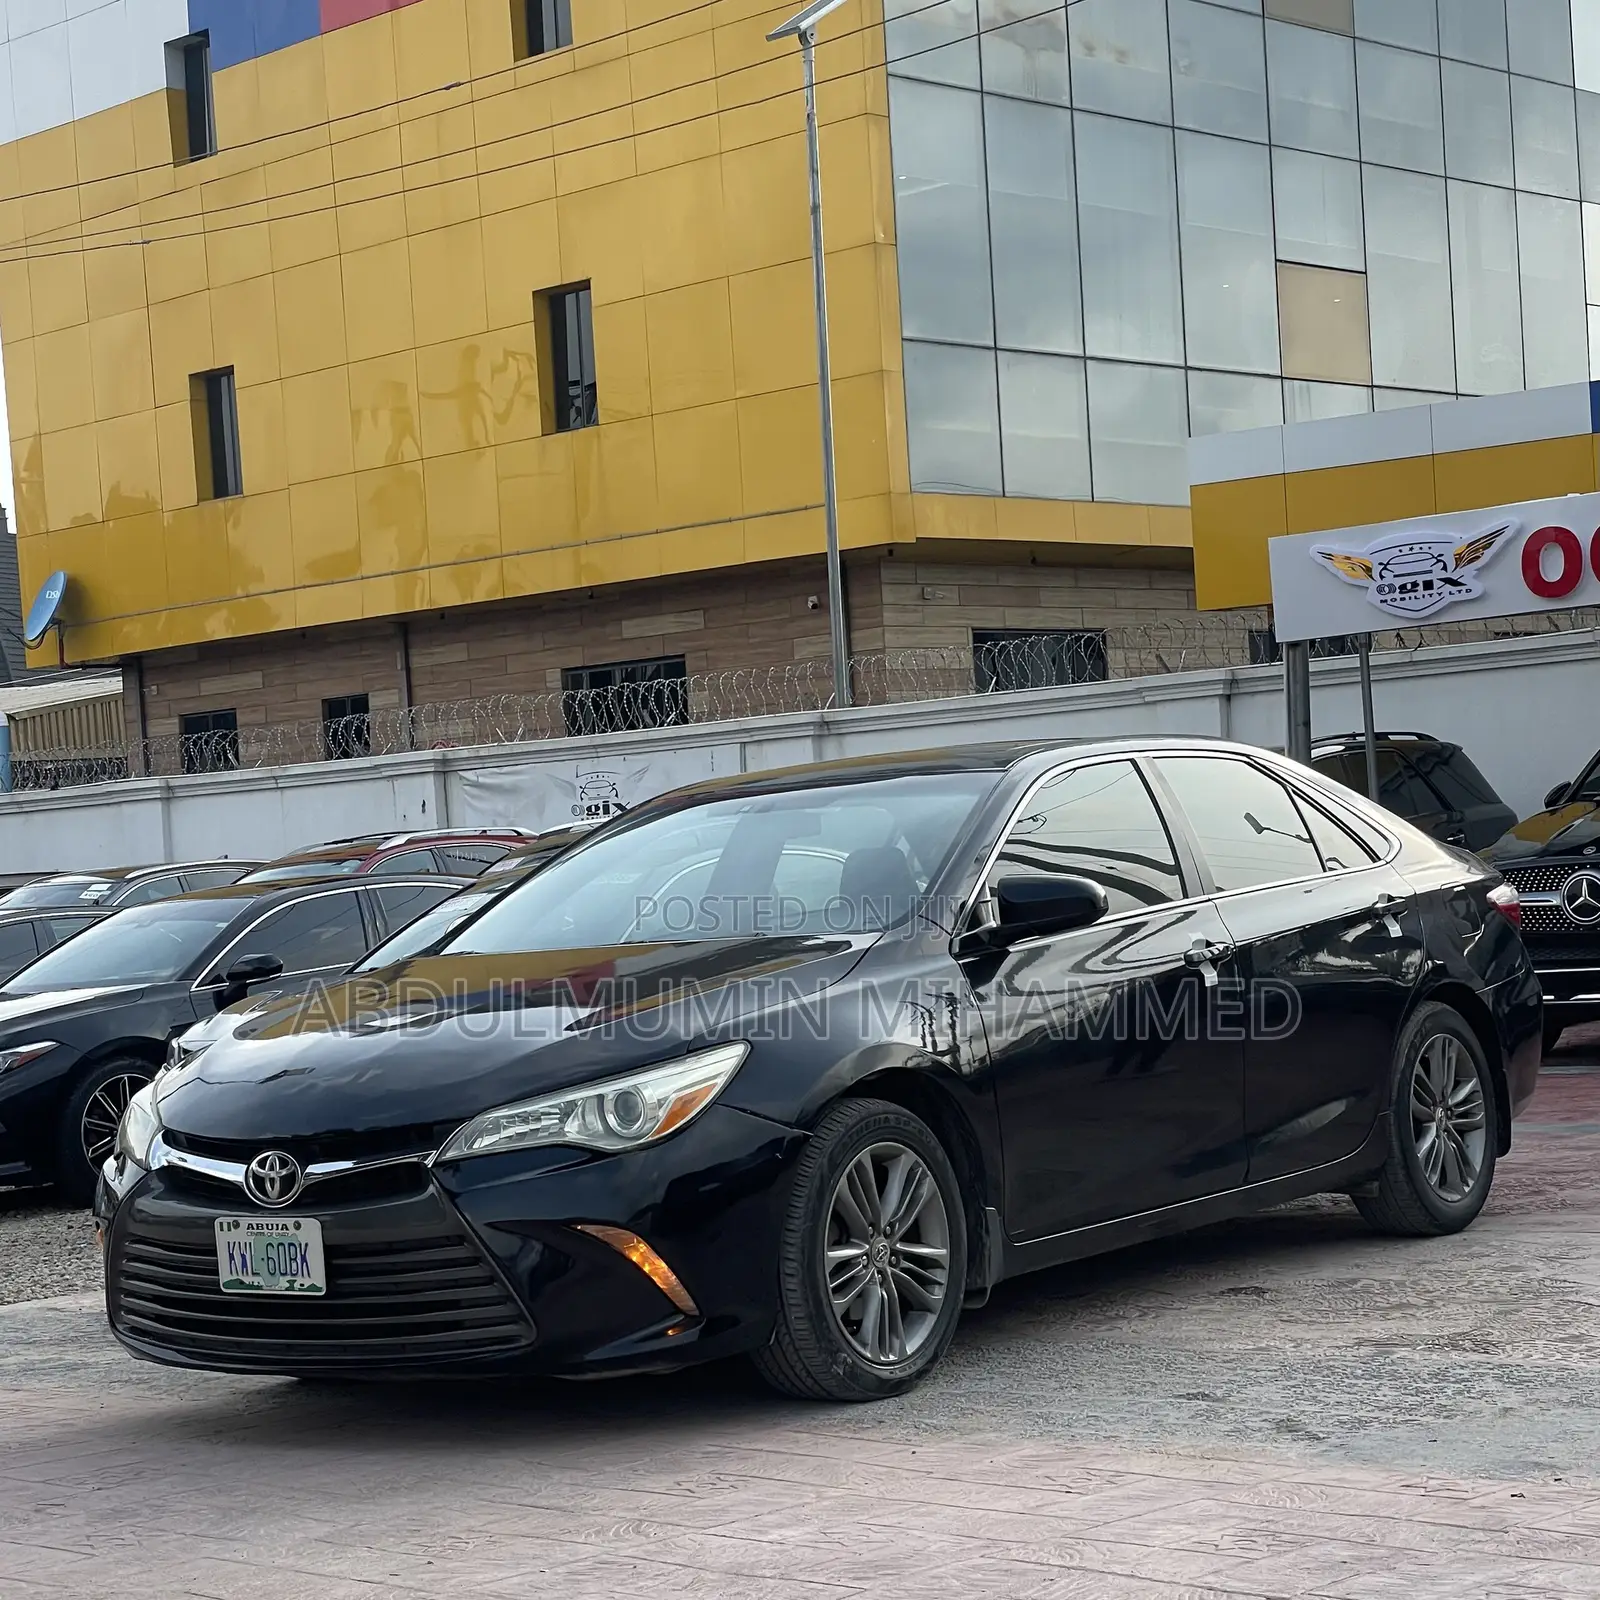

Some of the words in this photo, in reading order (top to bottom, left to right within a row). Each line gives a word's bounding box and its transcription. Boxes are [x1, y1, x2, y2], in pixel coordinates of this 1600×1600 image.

[1521, 525, 1600, 598] O
[1379, 591, 1443, 604] MOBILITY
[1448, 588, 1473, 596] LTD
[246, 1223, 290, 1231] ABUJA
